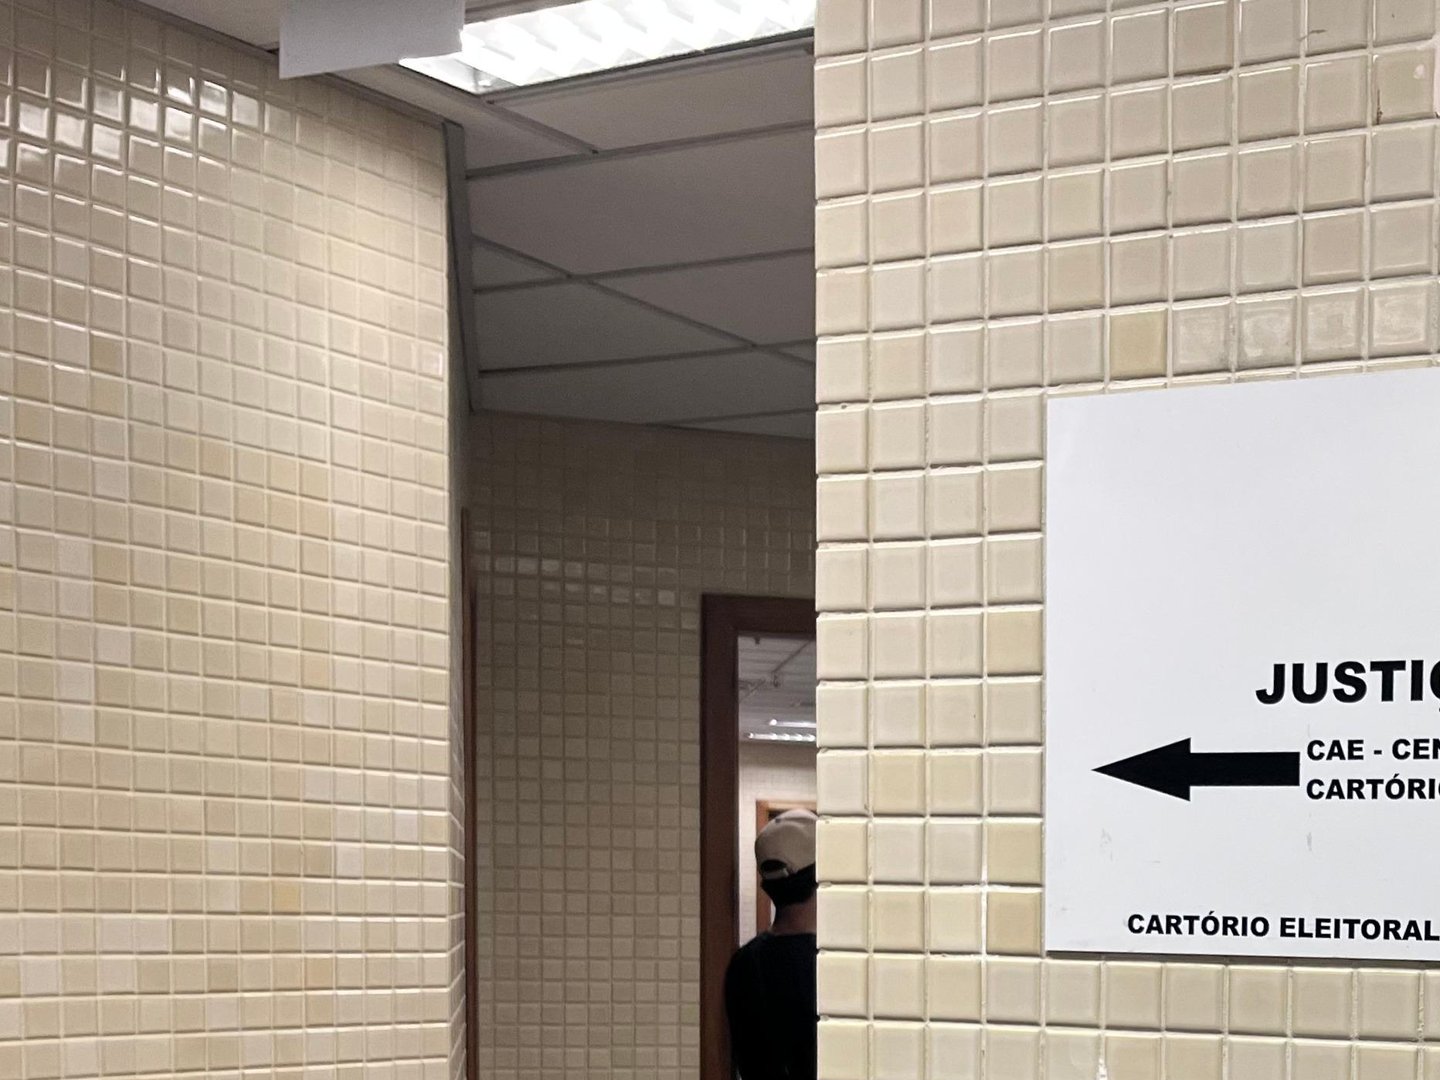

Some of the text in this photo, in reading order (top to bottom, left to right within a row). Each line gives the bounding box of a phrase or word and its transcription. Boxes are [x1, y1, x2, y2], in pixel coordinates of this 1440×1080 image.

[1306, 739, 1364, 761] CAE
[1127, 910, 1440, 942] CARTÓRIO ELEITORAL
